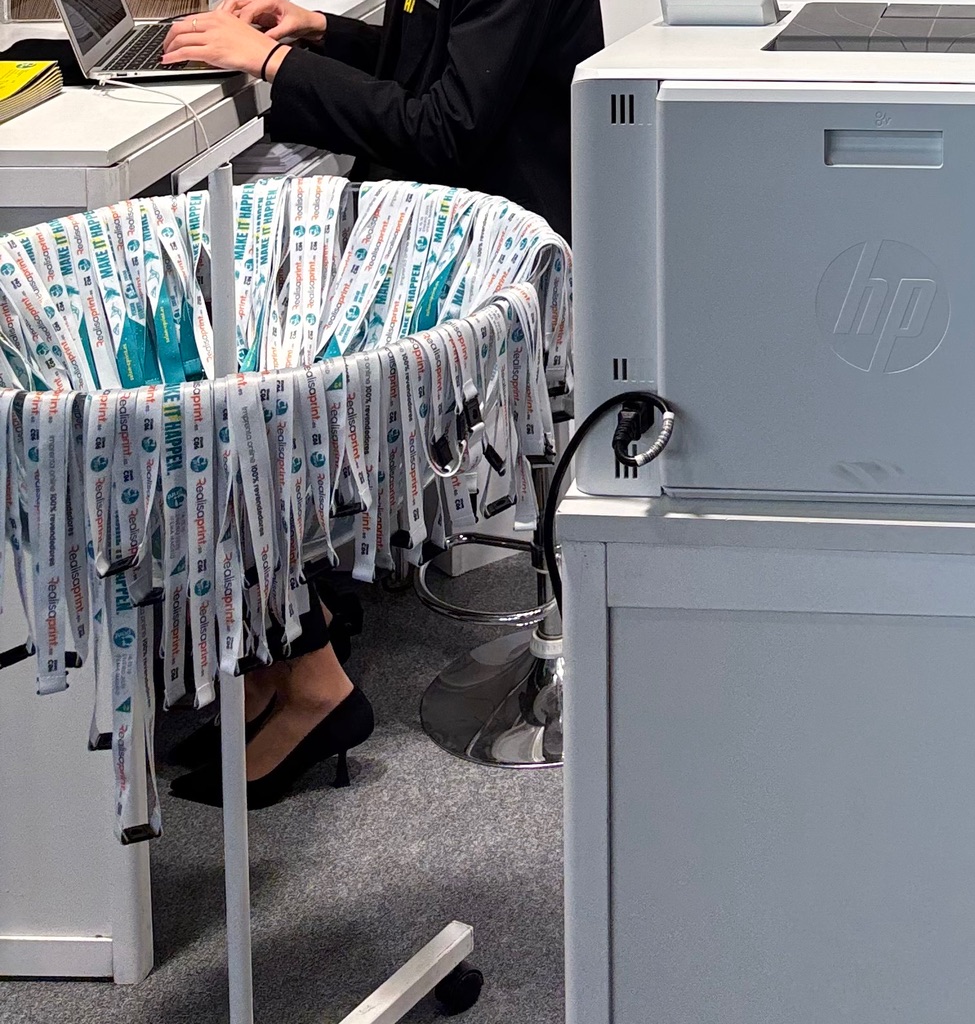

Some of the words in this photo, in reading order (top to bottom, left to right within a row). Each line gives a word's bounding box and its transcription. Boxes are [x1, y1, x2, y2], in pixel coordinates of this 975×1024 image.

[238, 220, 250, 232] IT
[434, 216, 447, 243] MAKE
[91, 237, 108, 250] IT
[234, 232, 249, 261] MAKE
[260, 238, 270, 266] MAKE
[58, 247, 73, 276] MAKE
[95, 250, 114, 280] MAKE
[833, 240, 937, 372] hp
[164, 384, 182, 403] AKE
[164, 404, 182, 418] IT
[165, 421, 183, 476] HAPPEN.
[251, 464, 259, 484] 100%
[253, 484, 265, 537] revendedores
